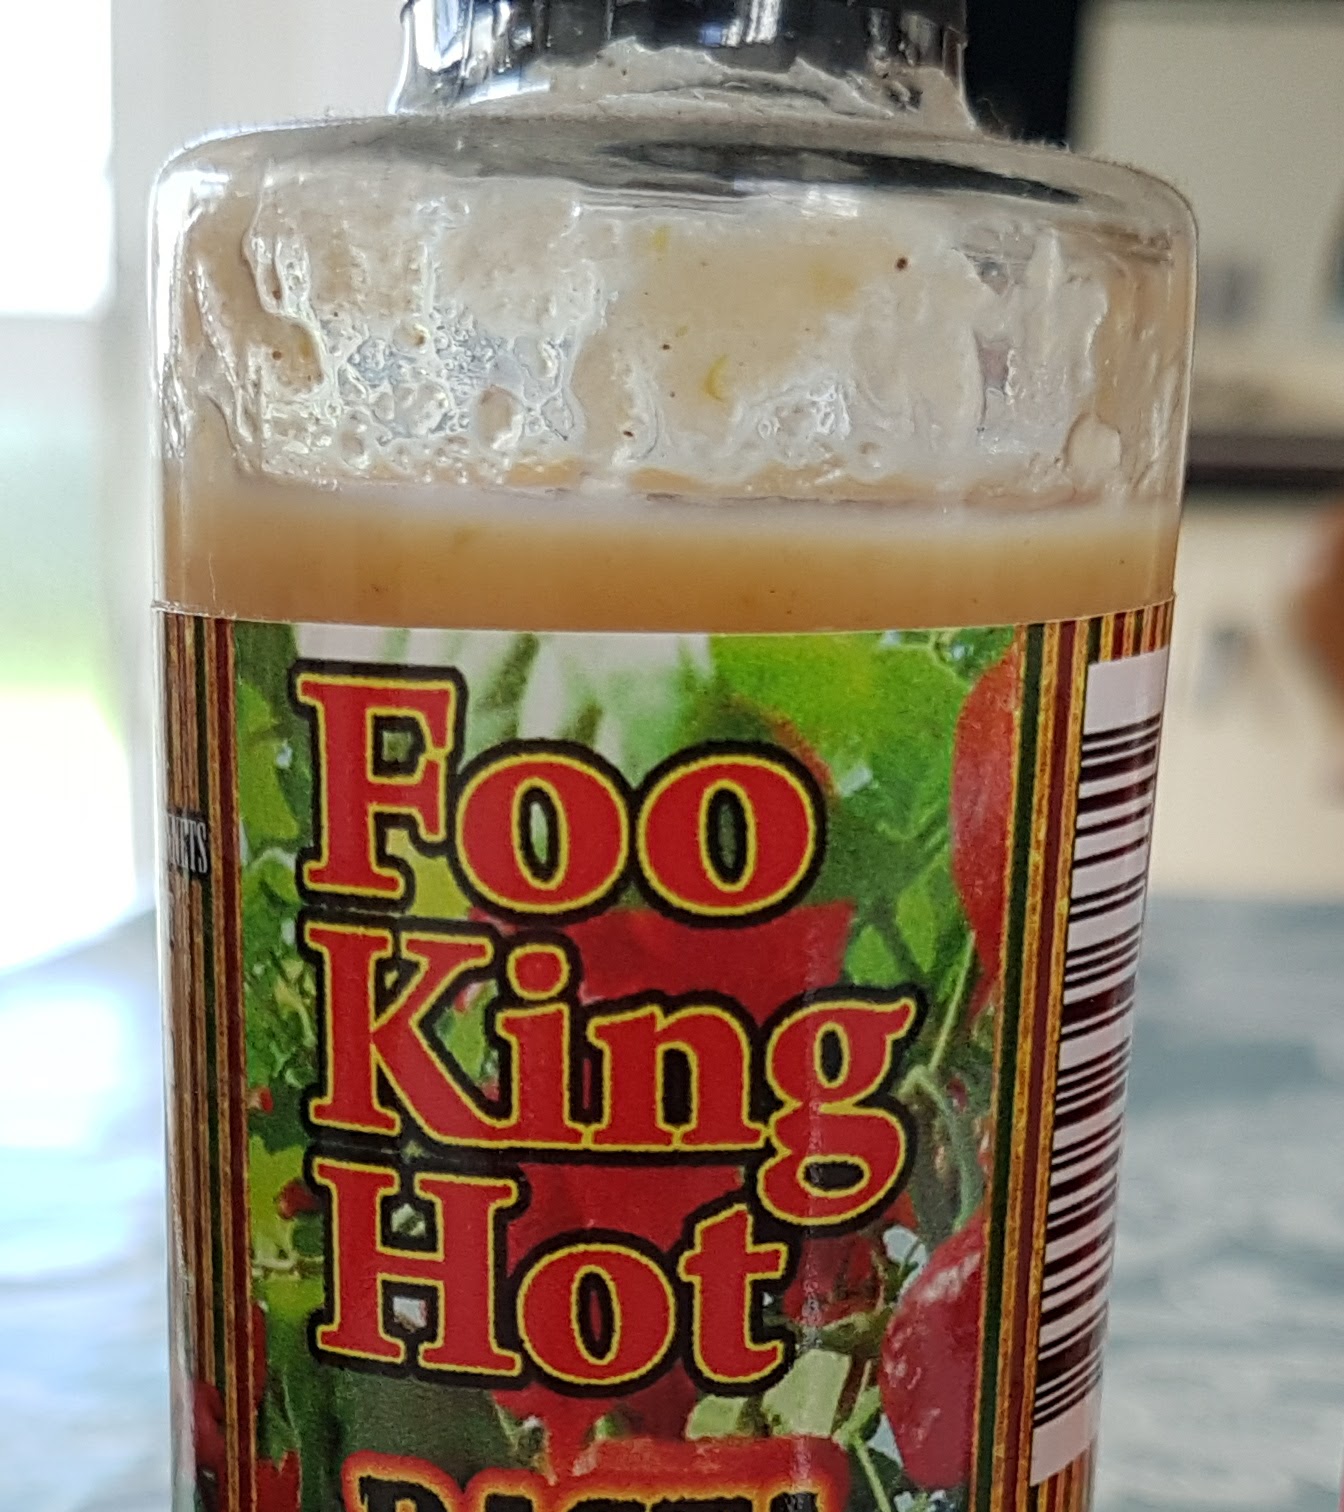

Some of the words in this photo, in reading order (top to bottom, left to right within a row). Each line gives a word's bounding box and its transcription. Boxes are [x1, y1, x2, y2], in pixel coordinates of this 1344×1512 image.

[294, 665, 822, 922] Foo
[304, 914, 922, 1229] King
[311, 1153, 794, 1389] Hot
